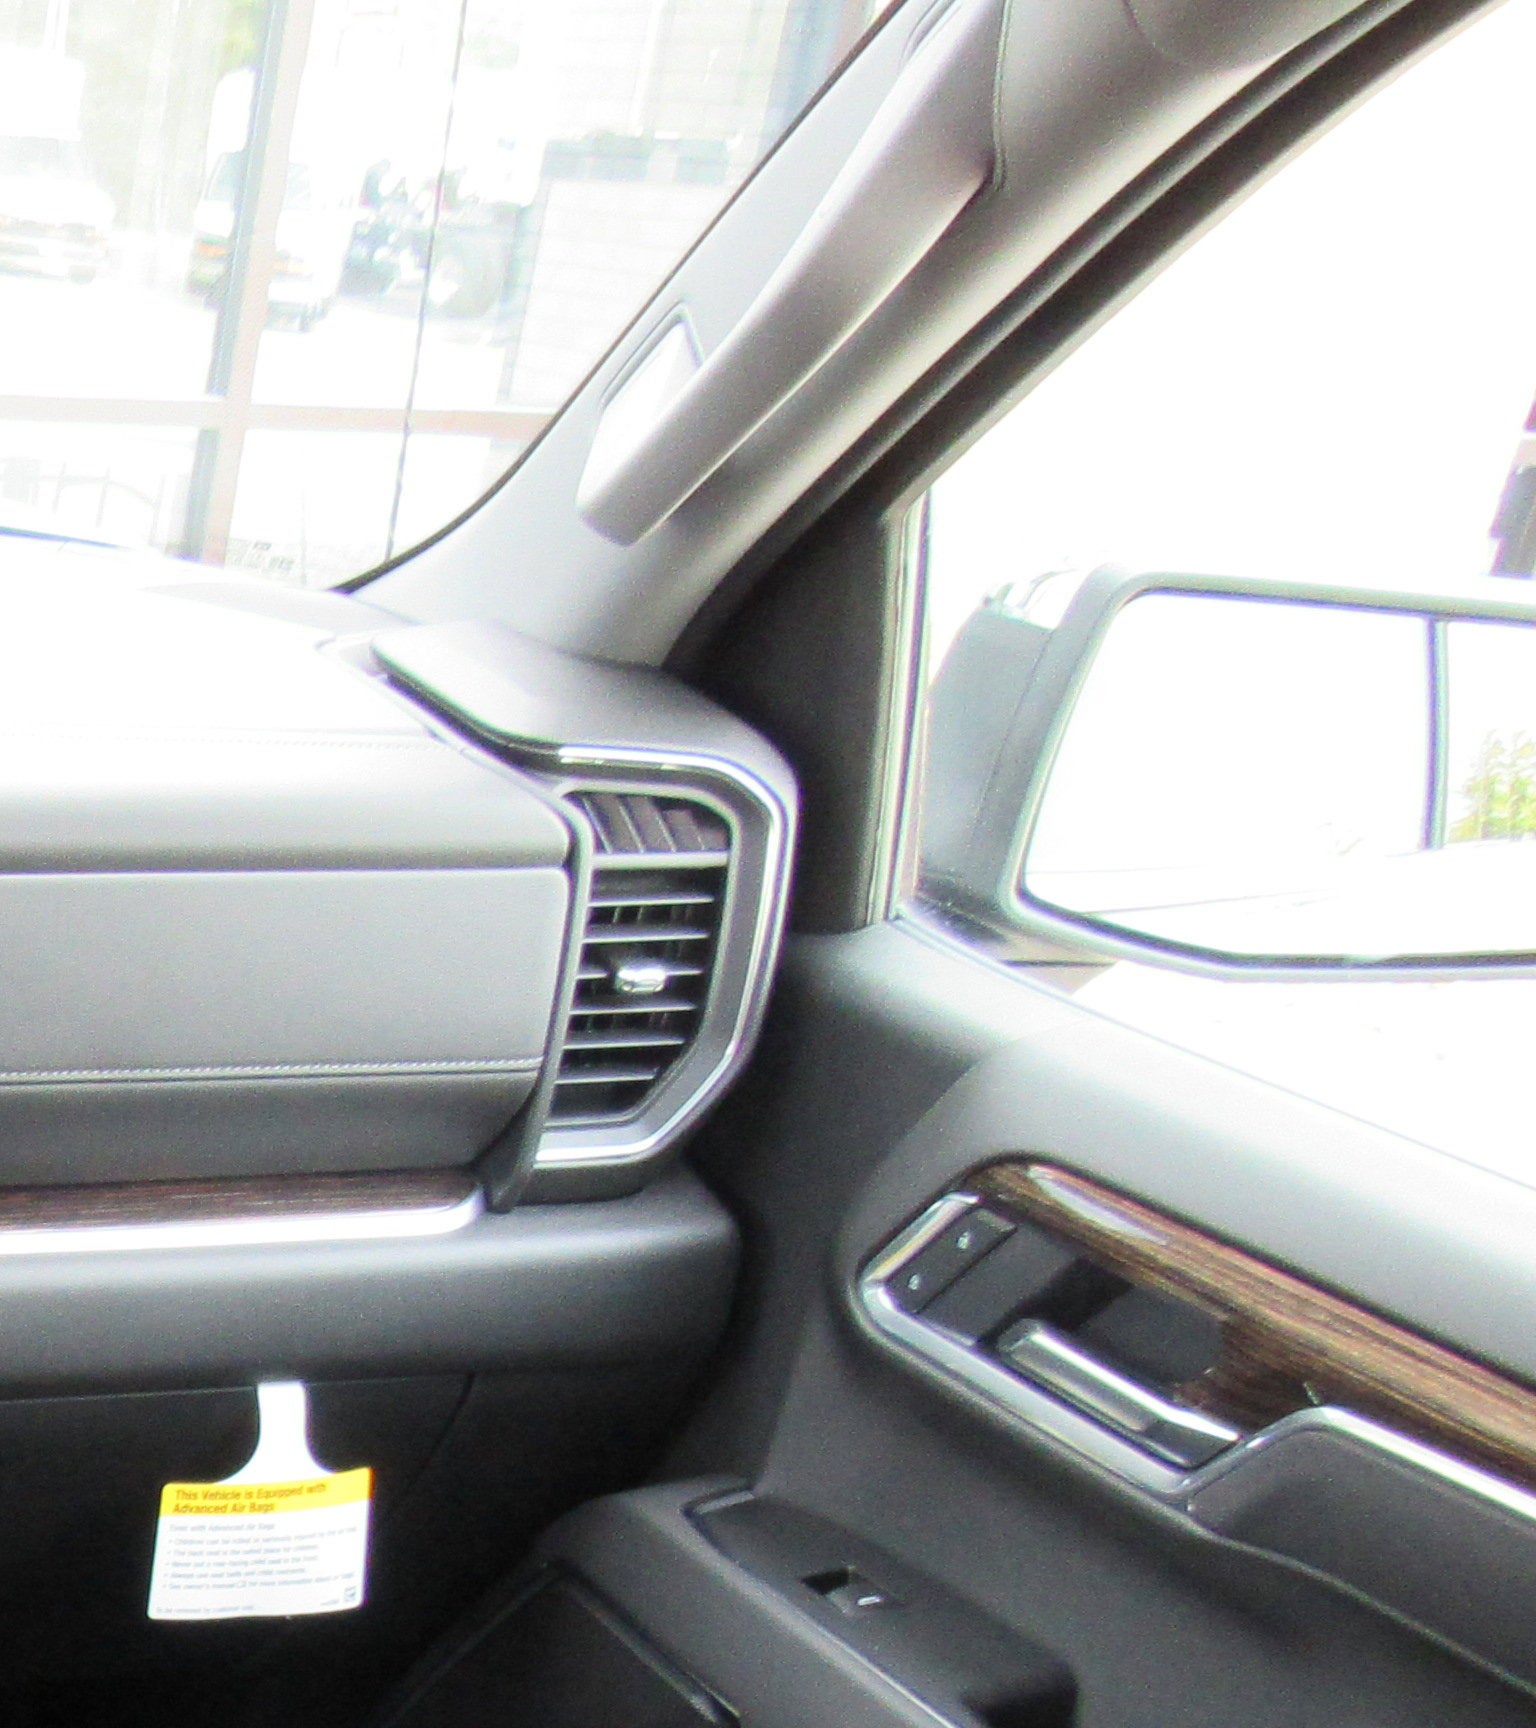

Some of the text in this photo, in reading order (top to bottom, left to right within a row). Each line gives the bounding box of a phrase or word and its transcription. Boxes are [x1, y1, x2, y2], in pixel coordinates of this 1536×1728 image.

[175, 1483, 327, 1500] This Vehicle is Equipped with
[172, 1502, 275, 1514] Advanced Air Bags
